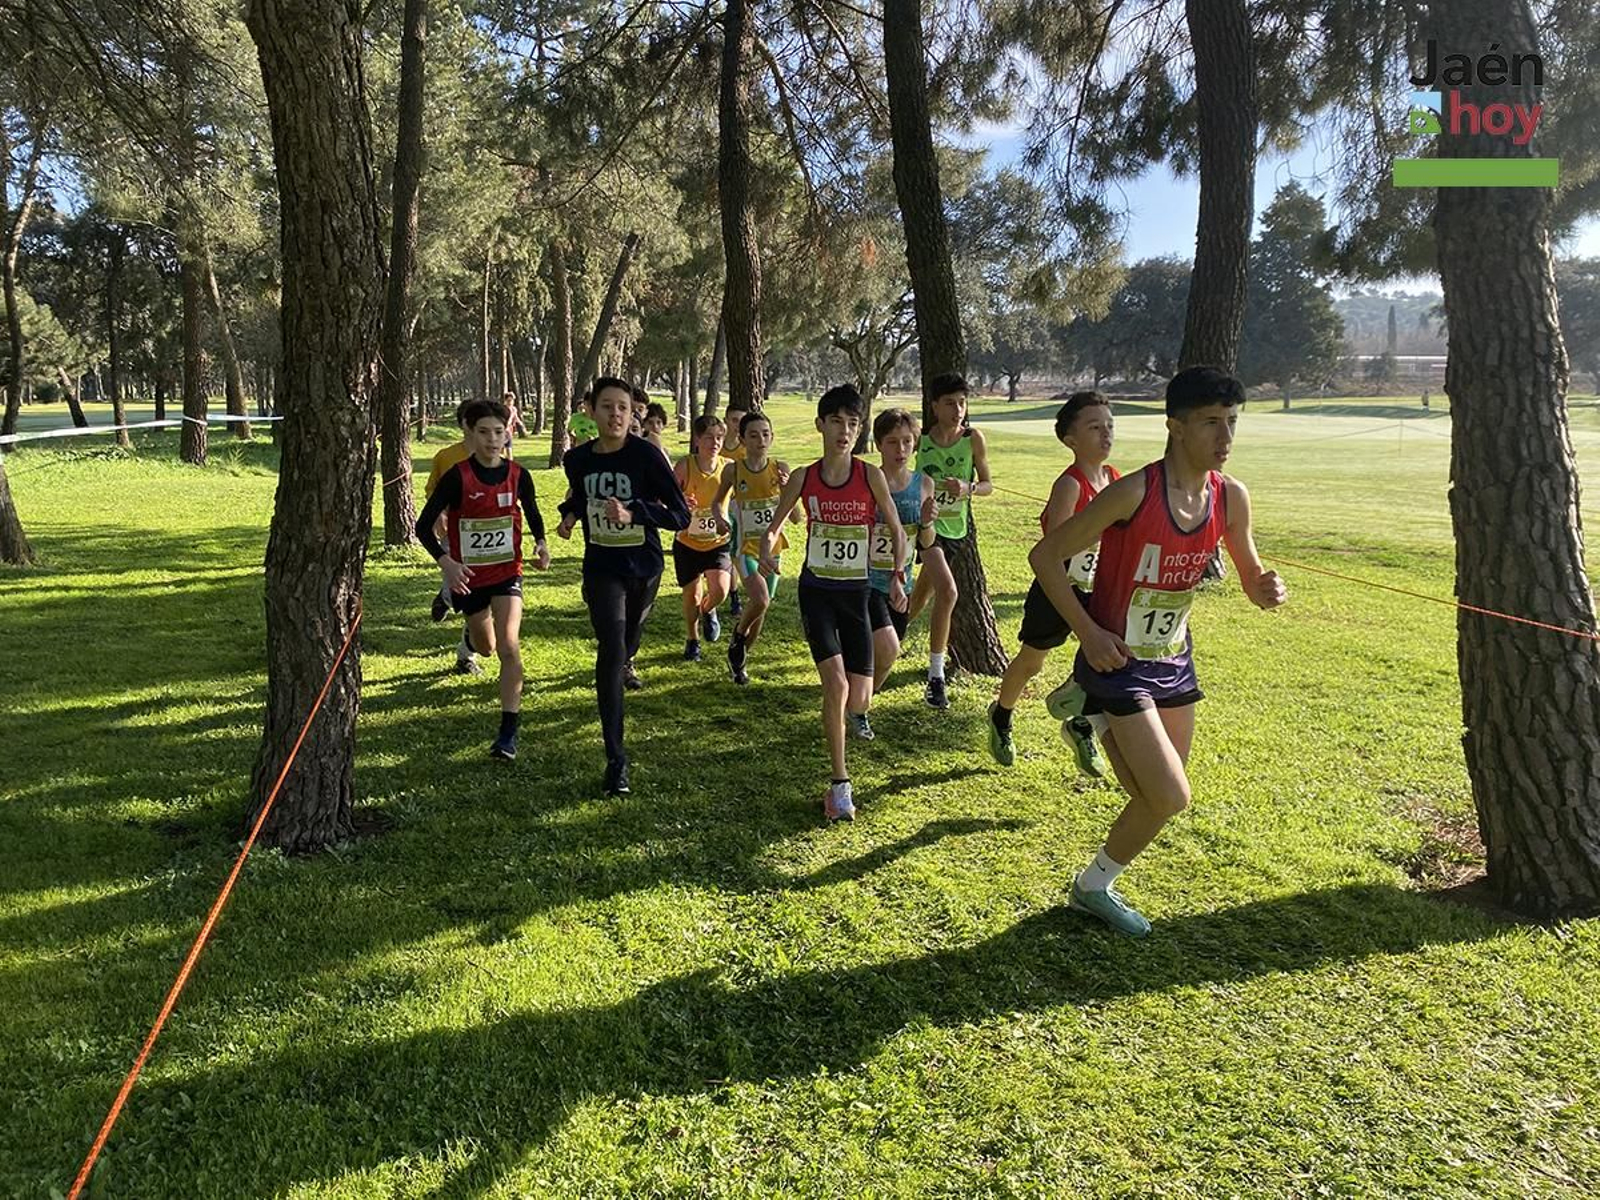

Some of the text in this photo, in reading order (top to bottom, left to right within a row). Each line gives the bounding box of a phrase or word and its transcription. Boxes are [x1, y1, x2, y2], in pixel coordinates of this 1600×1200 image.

[583, 471, 632, 499] UCB
[699, 517, 715, 530] 36
[754, 509, 773, 525] 38
[470, 531, 506, 549] 222
[820, 540, 859, 560] 130
